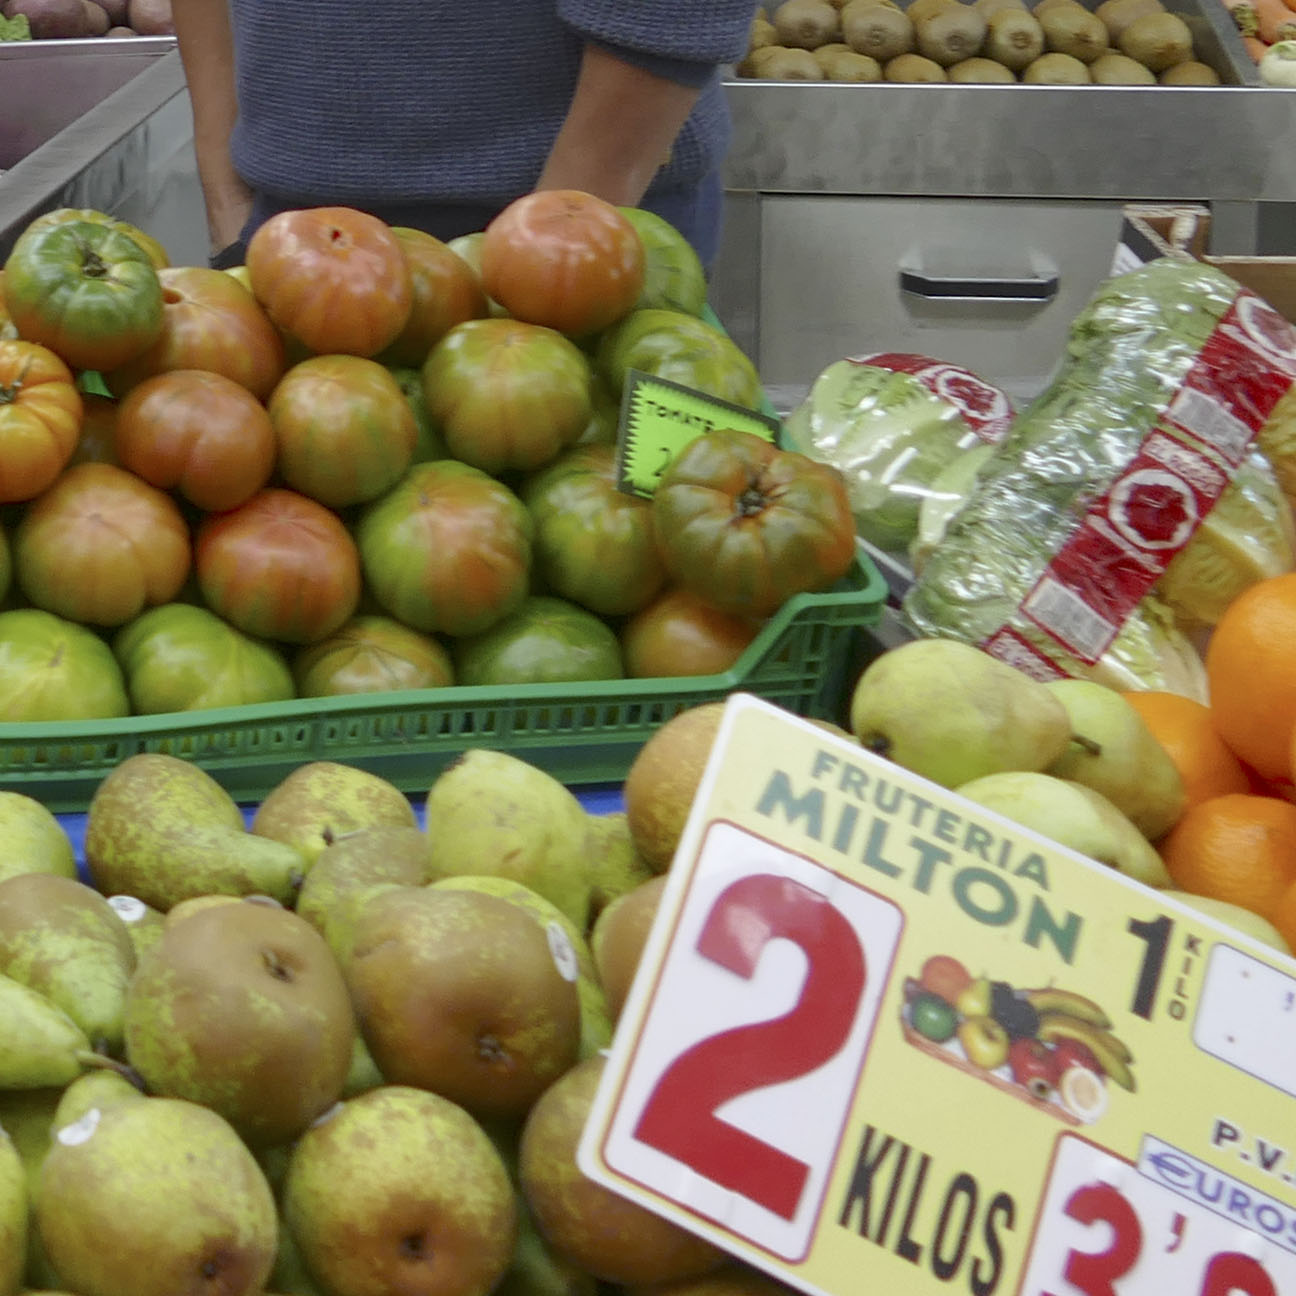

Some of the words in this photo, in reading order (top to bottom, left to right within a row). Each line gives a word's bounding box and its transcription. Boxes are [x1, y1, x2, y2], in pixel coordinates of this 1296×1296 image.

[755, 769, 1084, 967] MILTON
[1127, 913, 1176, 1022] 1
[810, 750, 1053, 891] FRUTERIA
[633, 872, 868, 1224] 2
[837, 1124, 1018, 1296] KILOS
